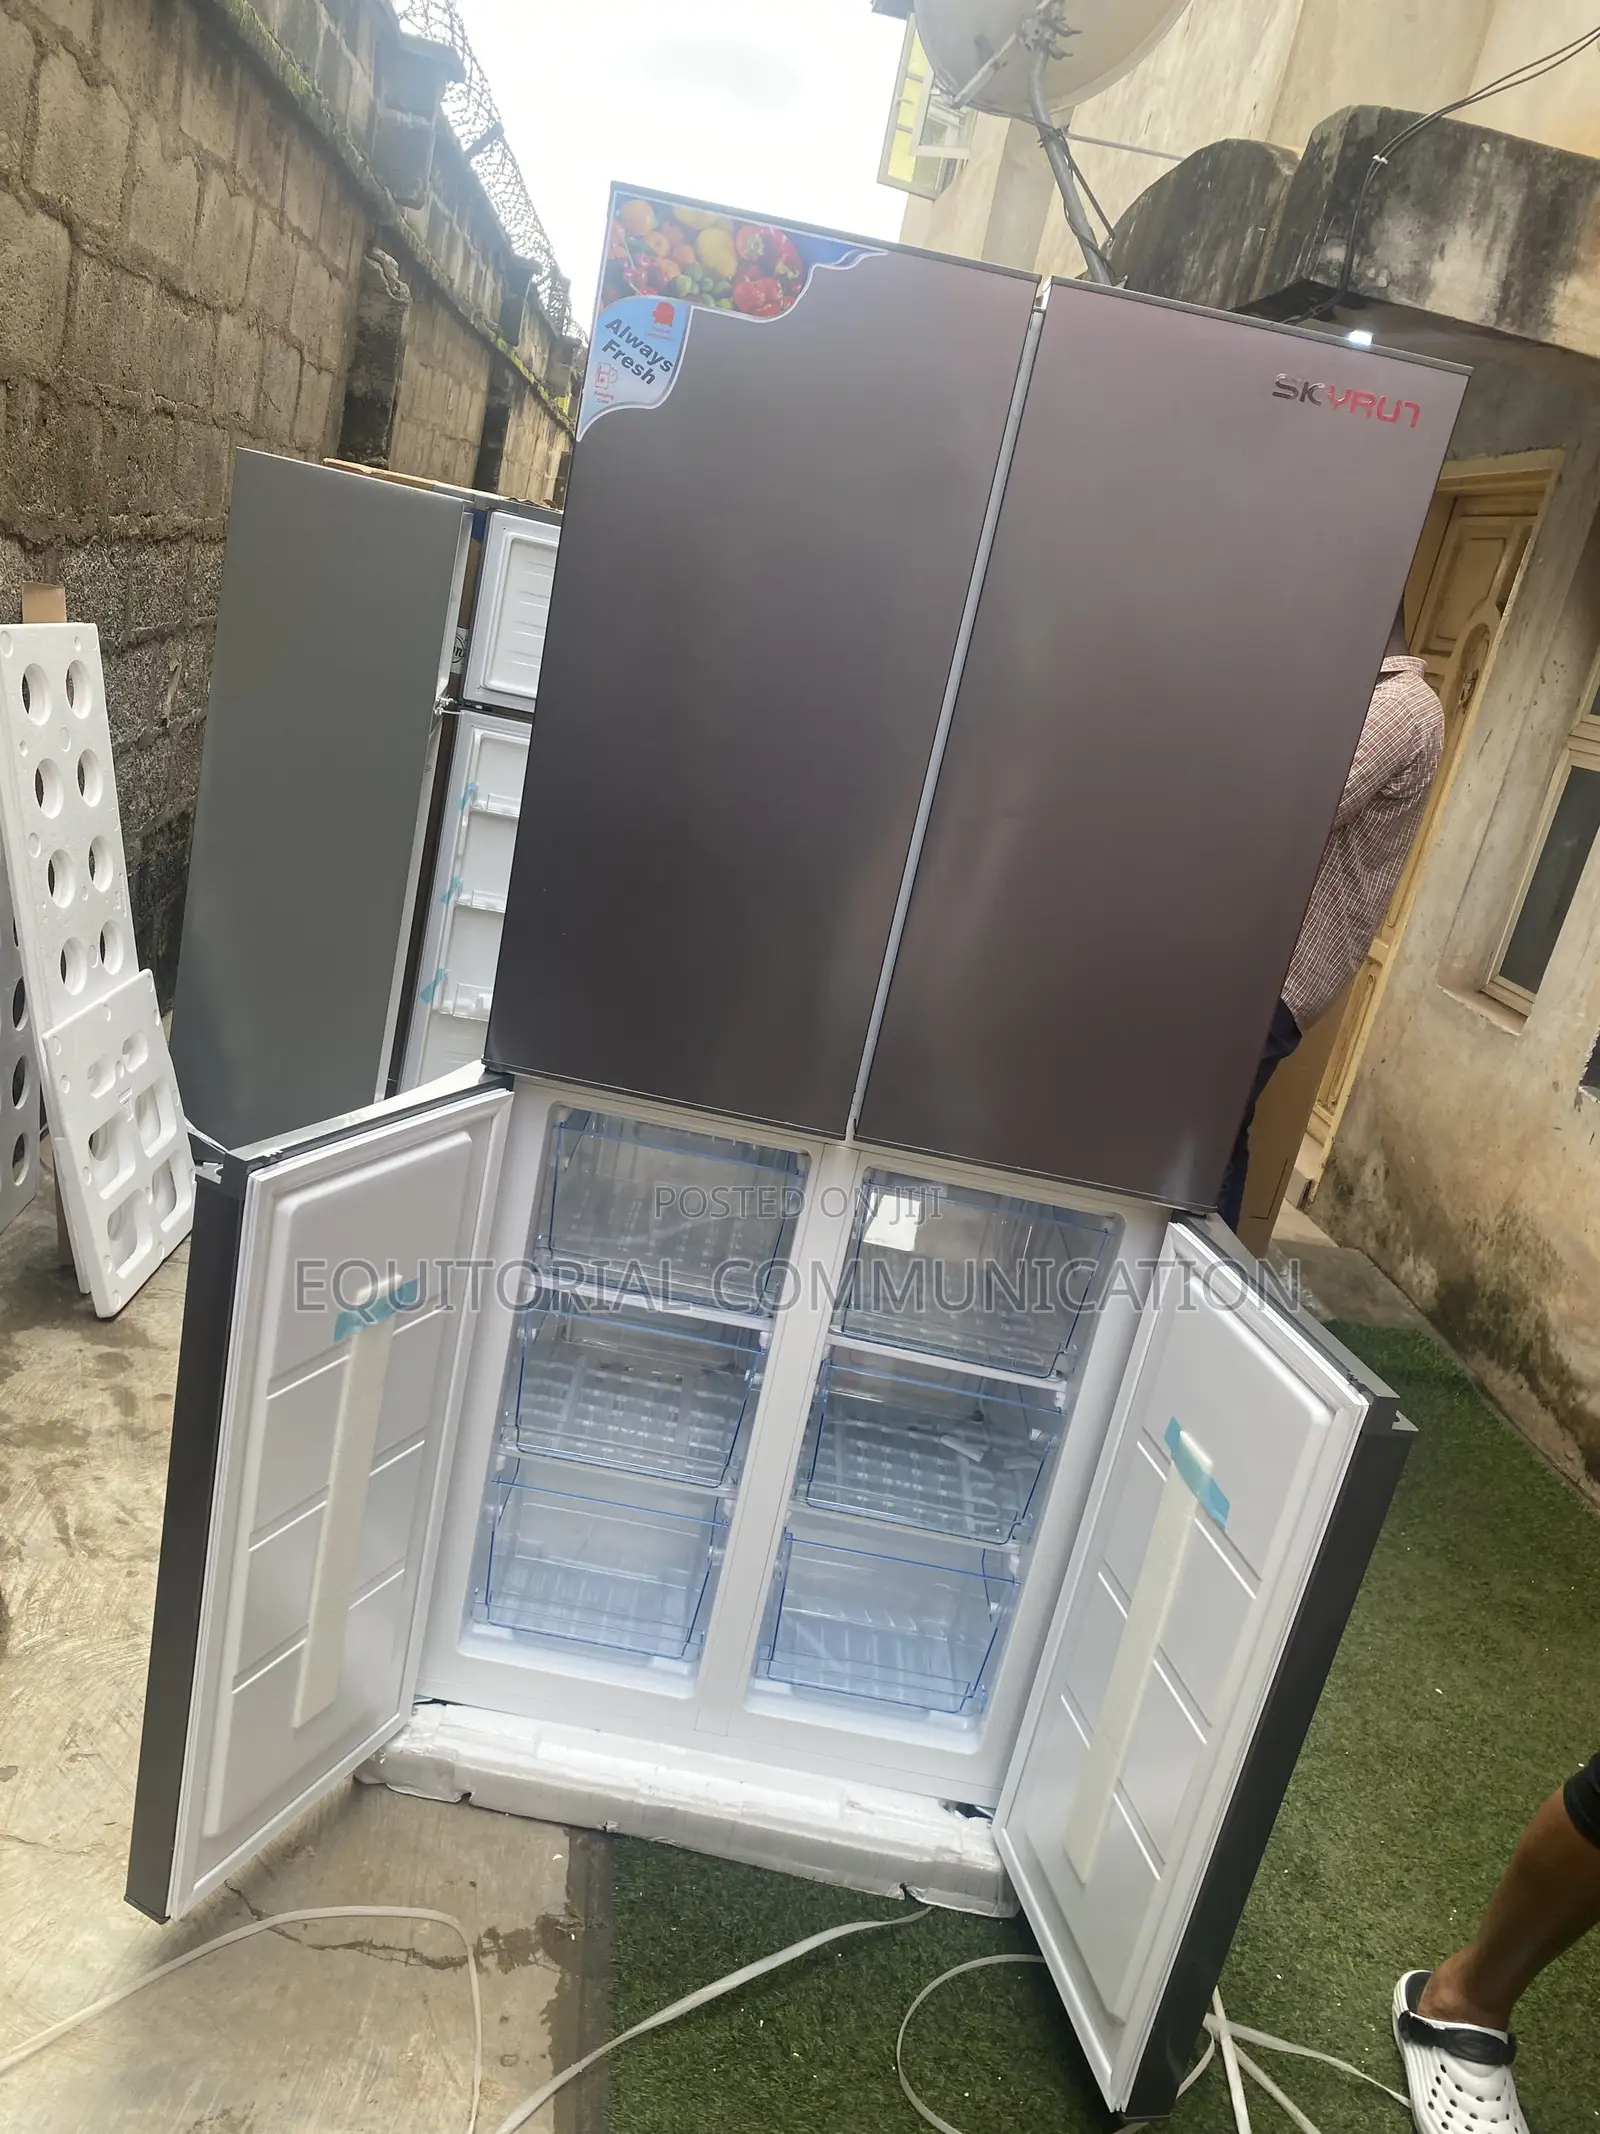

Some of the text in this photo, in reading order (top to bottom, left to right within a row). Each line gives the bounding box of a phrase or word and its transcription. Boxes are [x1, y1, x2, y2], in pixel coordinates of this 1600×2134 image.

[602, 339, 656, 385] Fresh
[605, 319, 673, 372] Always
[1272, 373, 1420, 428] SKYRUN
